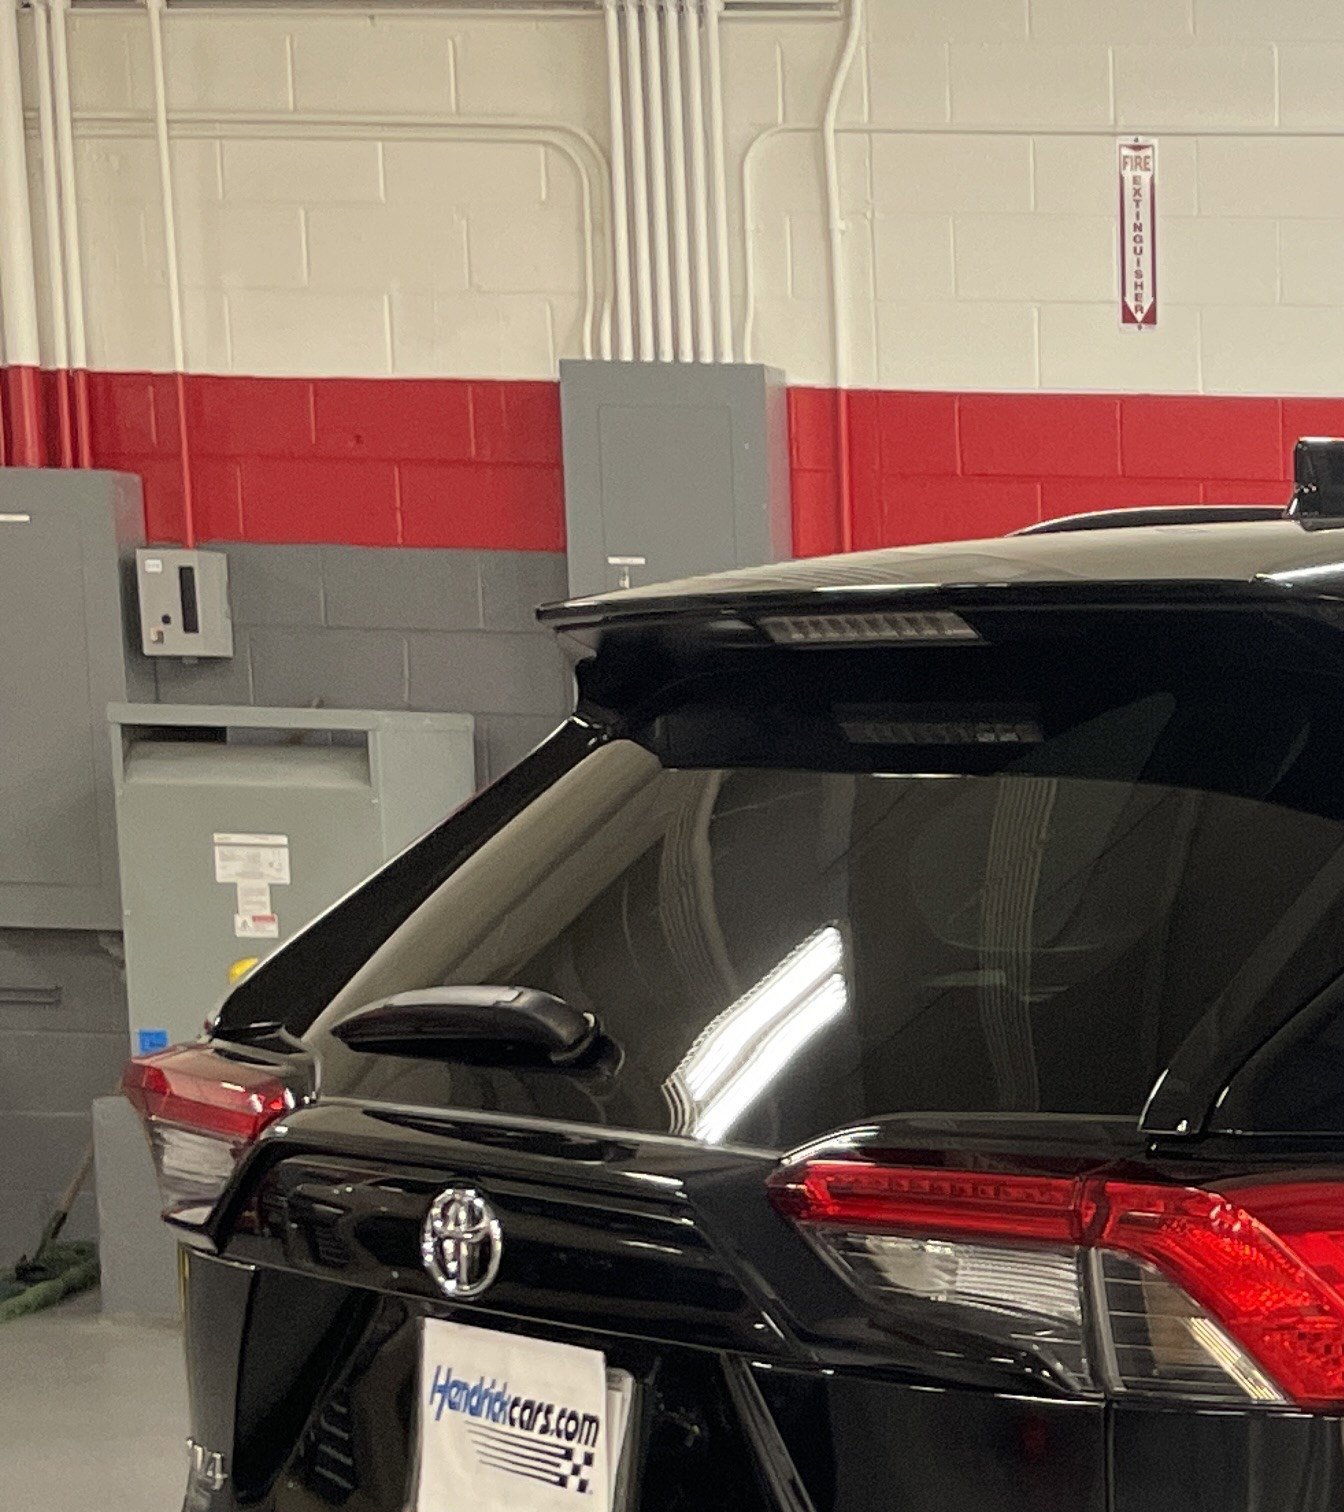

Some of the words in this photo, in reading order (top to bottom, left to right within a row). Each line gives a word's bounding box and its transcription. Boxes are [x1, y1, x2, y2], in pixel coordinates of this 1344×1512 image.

[1122, 155, 1151, 172] FIRE
[1132, 175, 1145, 314] EXTINGUISHER
[428, 1364, 601, 1448] Hendrickcars.com
